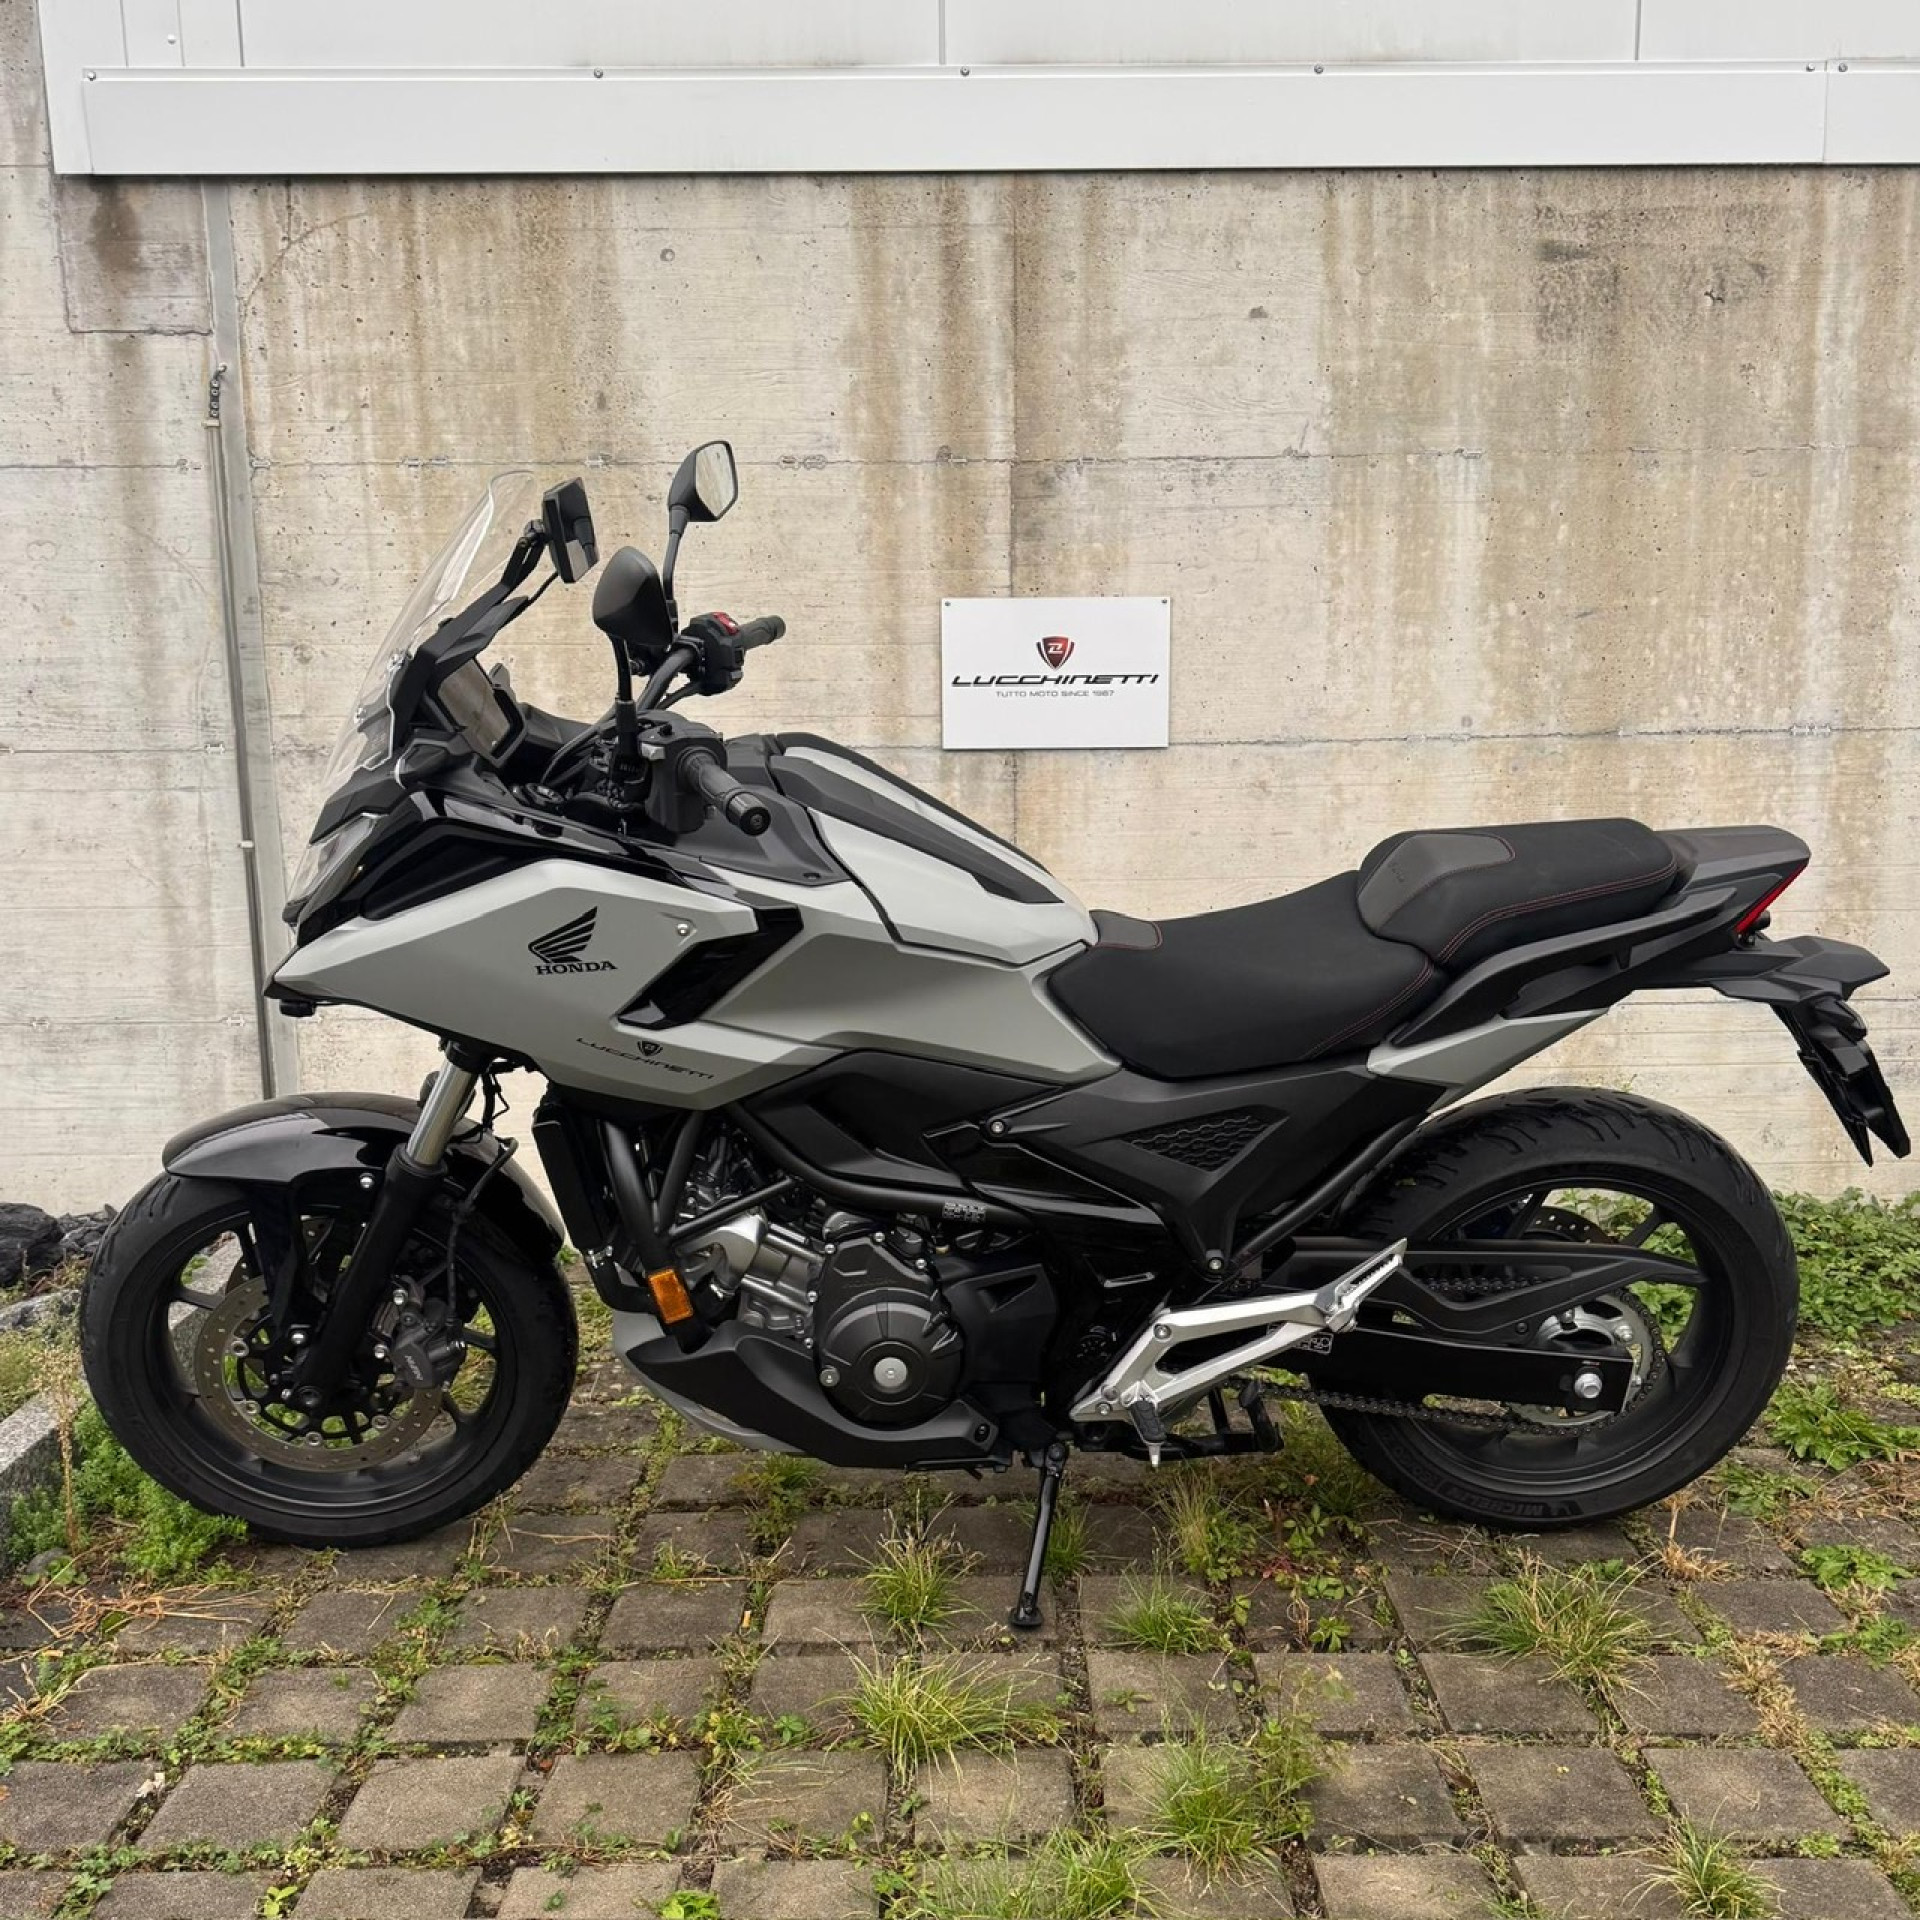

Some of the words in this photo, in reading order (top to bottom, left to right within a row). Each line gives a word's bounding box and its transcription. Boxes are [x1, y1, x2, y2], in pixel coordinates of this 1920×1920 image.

[951, 674, 1159, 687] LUCCHINETTI
[996, 690, 1027, 698] TUTTO
[1029, 690, 1059, 698] MOTO
[534, 960, 619, 975] HONDA
[576, 1037, 715, 1079] LUCCHINETTI
